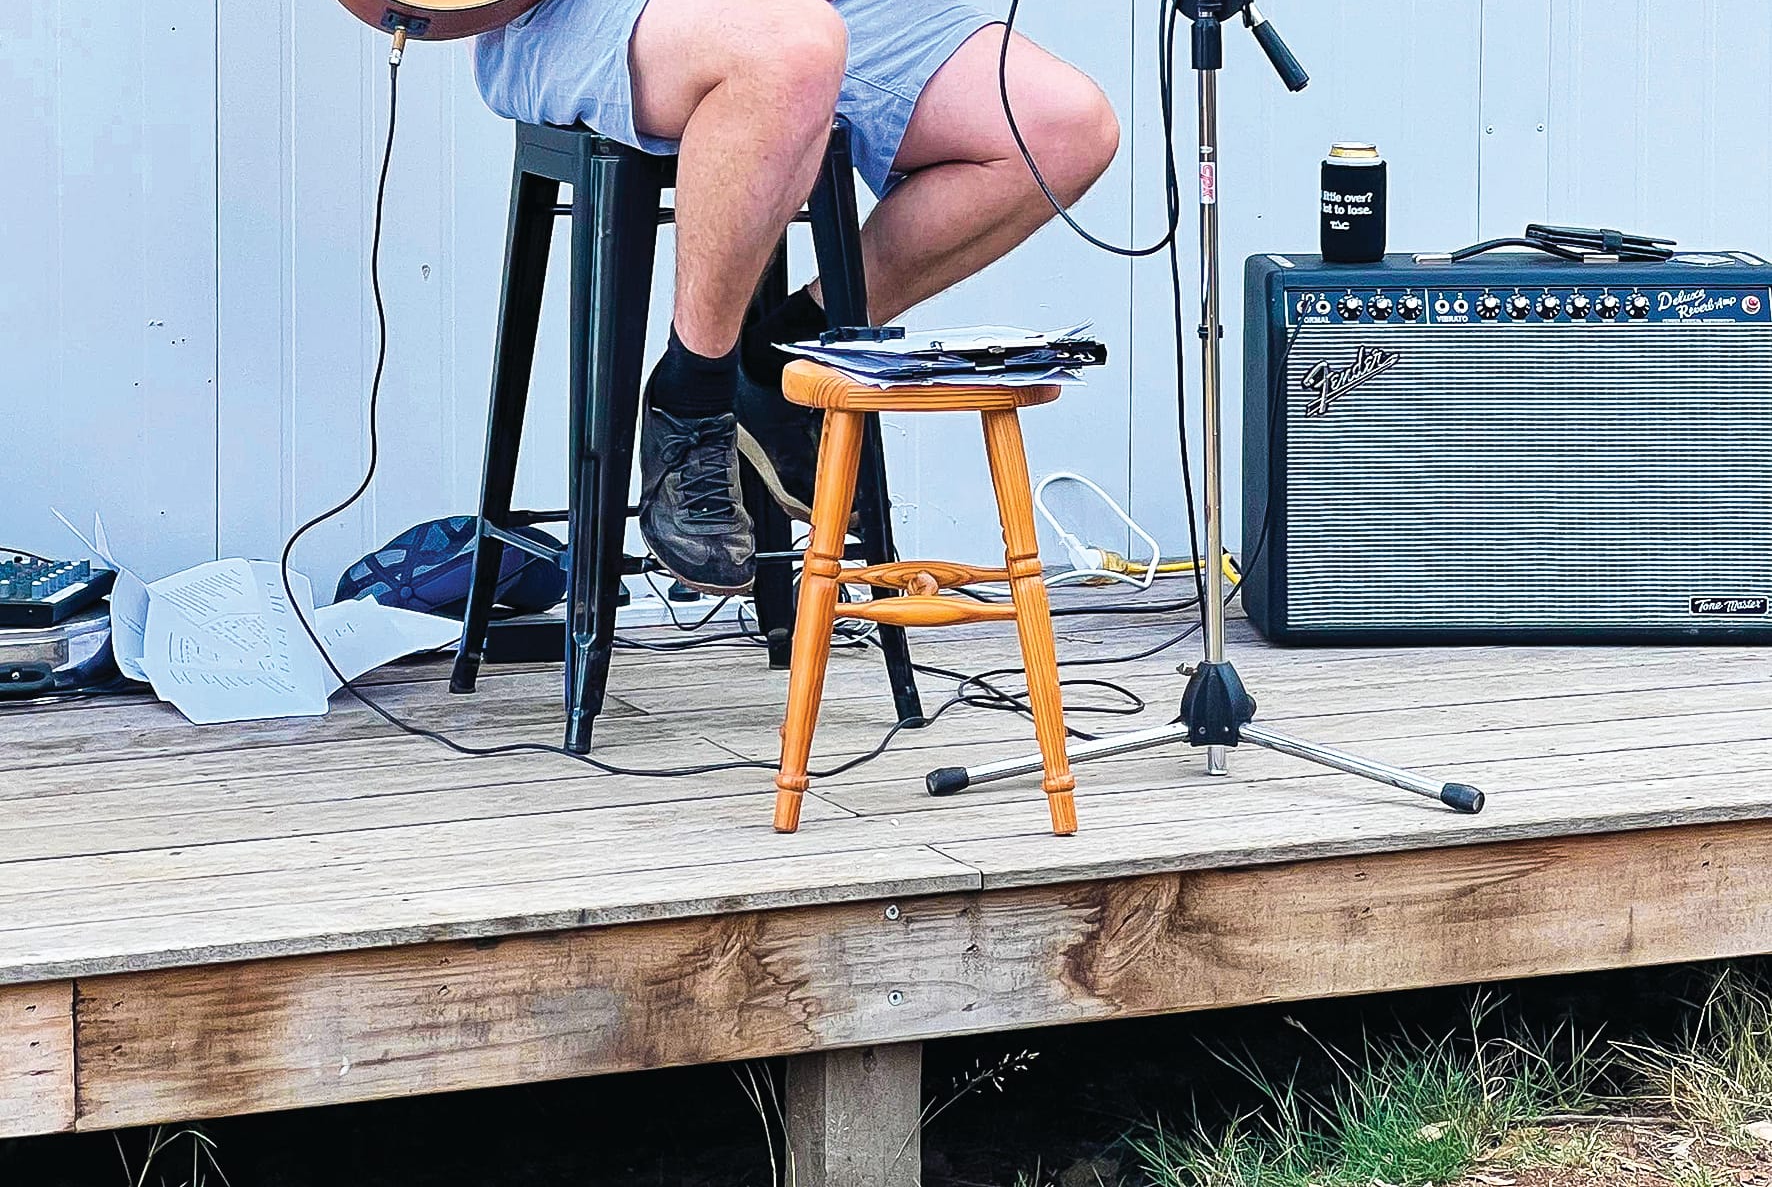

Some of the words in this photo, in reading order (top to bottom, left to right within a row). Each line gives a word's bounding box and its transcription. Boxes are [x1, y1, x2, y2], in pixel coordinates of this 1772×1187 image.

[1344, 192, 1373, 203] over?
[1334, 204, 1346, 215] to
[1657, 289, 1706, 311] Deluxe
[1303, 344, 1399, 416] Fender
[1694, 598, 1723, 613] Tone
[1724, 599, 1764, 613] Master
